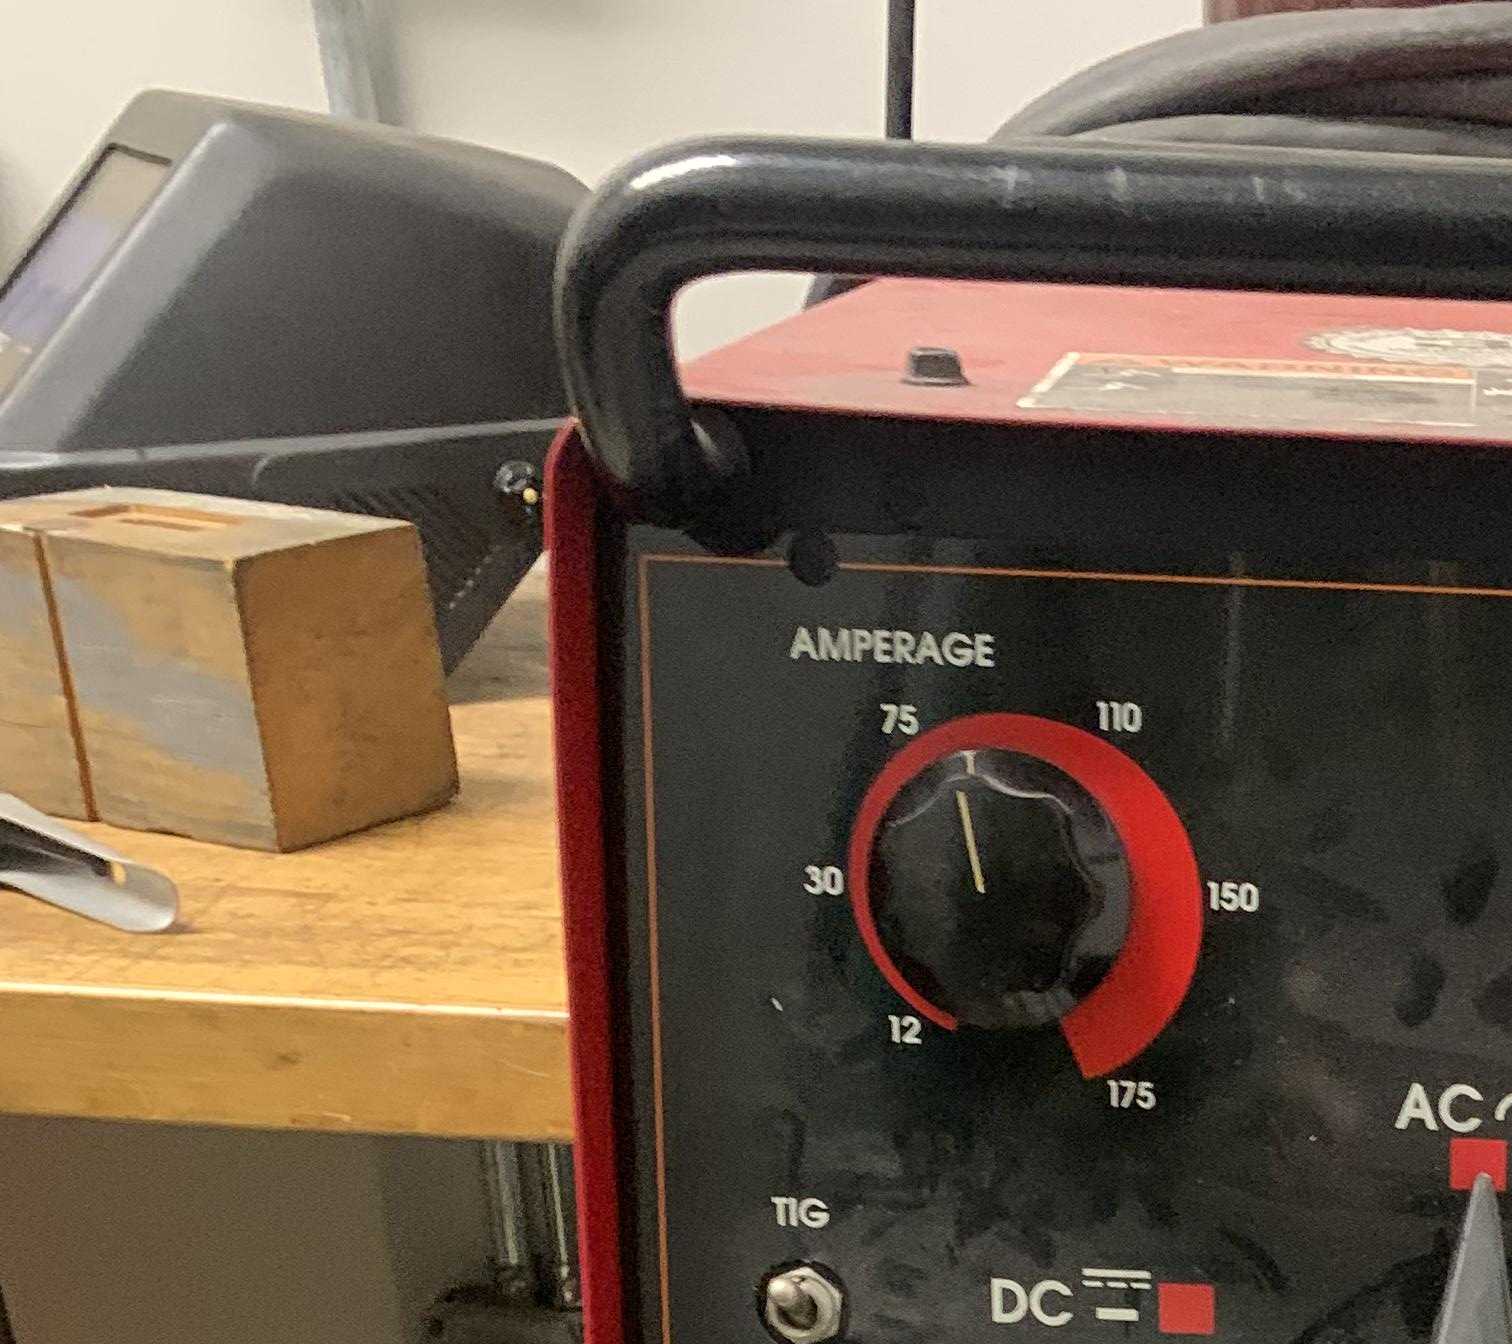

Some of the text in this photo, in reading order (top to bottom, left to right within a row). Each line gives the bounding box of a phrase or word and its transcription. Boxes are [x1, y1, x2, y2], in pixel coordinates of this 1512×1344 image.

[790, 627, 994, 667] AMPERAGE
[880, 704, 919, 735] 75
[1096, 701, 1142, 732] 110
[804, 865, 843, 895] 30
[1207, 882, 1259, 912] 150
[888, 1015, 921, 1044] 12
[1107, 1080, 1156, 1109] 175
[1395, 1083, 1483, 1132] AC
[771, 1197, 829, 1228] TIG
[991, 1278, 1073, 1326] DC
